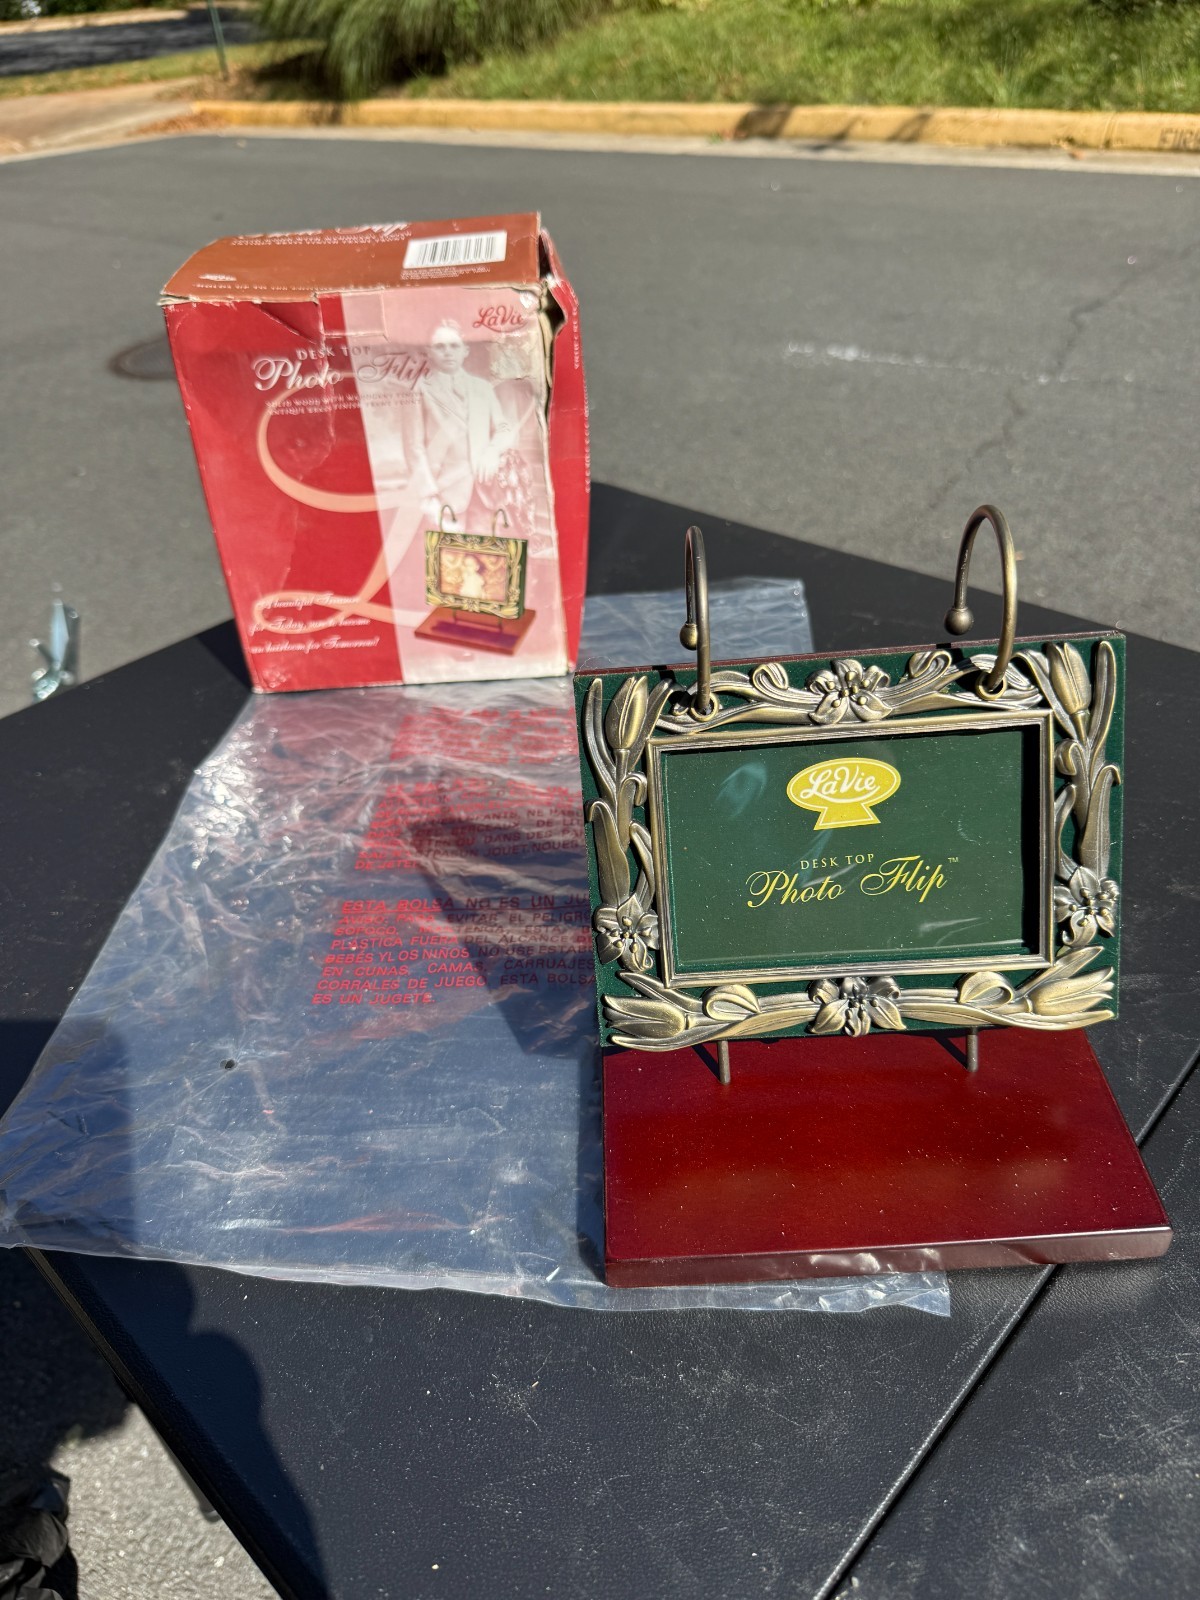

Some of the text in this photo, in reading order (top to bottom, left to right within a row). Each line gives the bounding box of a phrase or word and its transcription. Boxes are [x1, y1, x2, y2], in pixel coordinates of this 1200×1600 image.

[295, 345, 371, 360] DESK TOP
[252, 351, 432, 391] Photo Flip
[800, 765, 880, 803] LaVie
[484, 832, 521, 844] DANS
[800, 853, 875, 870] DESK TOP
[745, 869, 846, 908] Photo
[860, 855, 947, 903] Flip
[342, 900, 386, 913] ESTA
[397, 898, 454, 911] BOLSA
[466, 897, 490, 909] NO
[499, 896, 520, 909] ES
[531, 895, 555, 908] UN
[446, 912, 498, 924] EVITAR
[508, 913, 525, 924] EL
[330, 937, 403, 951] PLÁSTICA
[410, 935, 459, 946] FUERA
[464, 935, 491, 945] DEL
[498, 933, 569, 944] ALCANCE
[324, 950, 374, 964] BEBÉS
[422, 945, 469, 959] NIÑOS
[478, 946, 500, 957] NO
[505, 946, 535, 956] USE
[322, 966, 344, 977] EN
[503, 959, 596, 970] CARRUAJES
[317, 973, 597, 991] CORRALES DE JUEGO ESTA BOLSA
[311, 992, 436, 1005] ES UN JUGETE.
